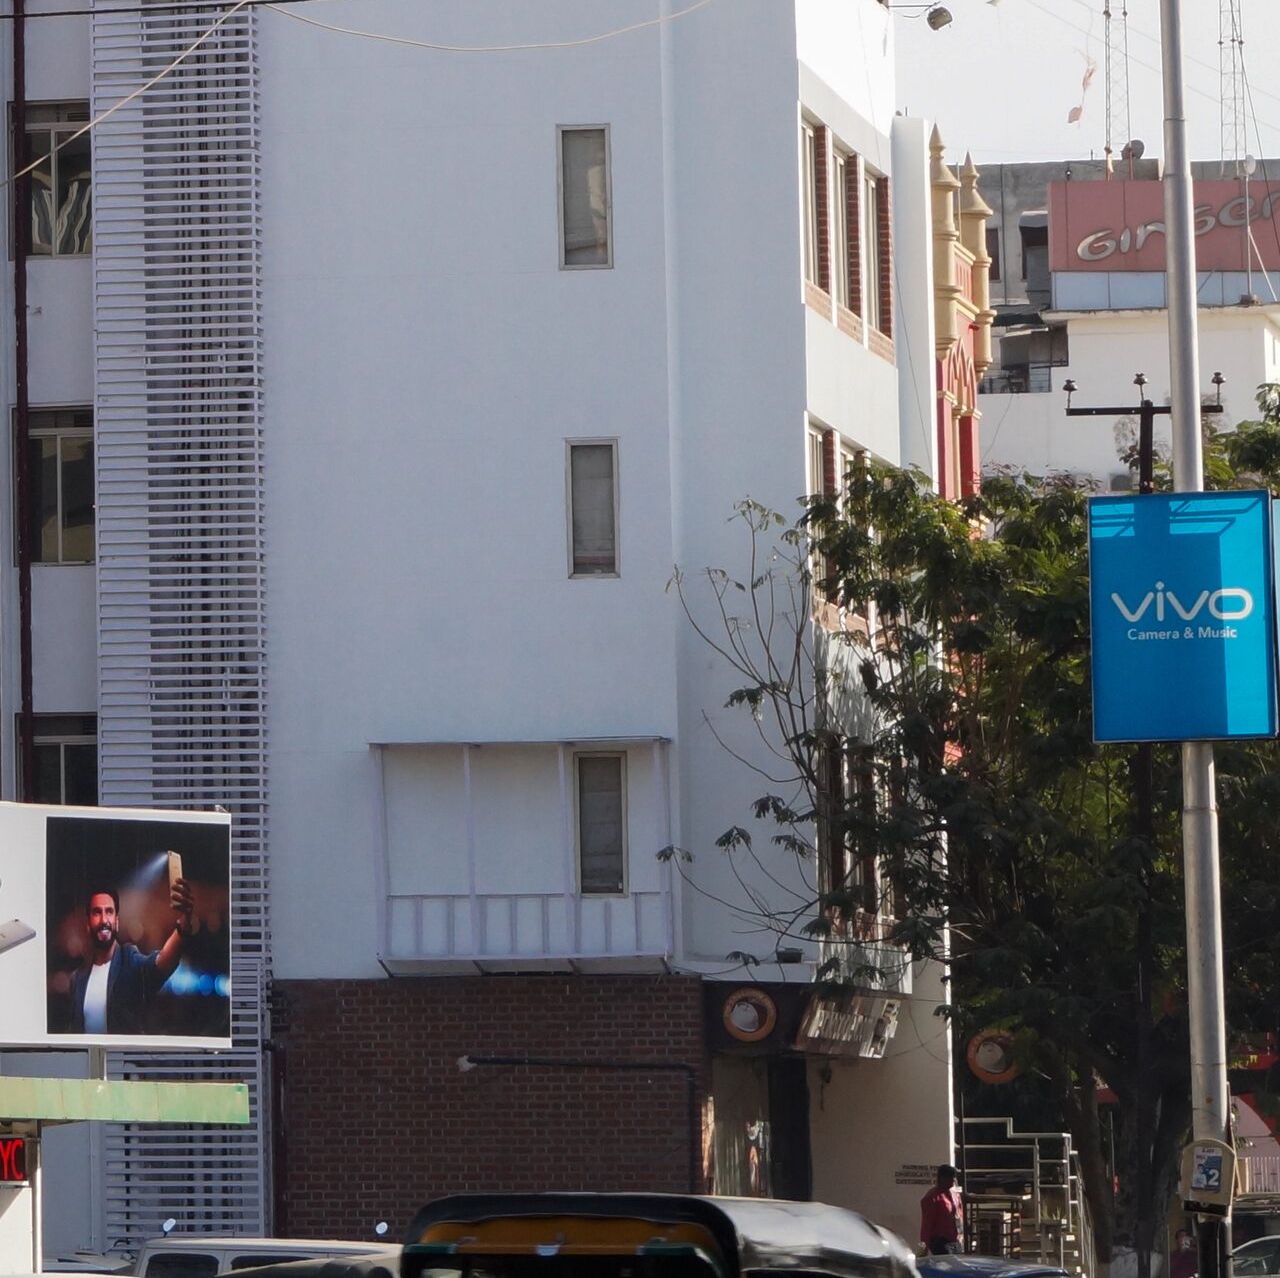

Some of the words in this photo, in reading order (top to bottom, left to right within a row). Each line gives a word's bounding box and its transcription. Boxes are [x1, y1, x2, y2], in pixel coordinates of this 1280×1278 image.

[1111, 580, 1254, 623] vivo
[1127, 628, 1180, 641] Camera
[1183, 626, 1194, 640] &
[1198, 625, 1238, 639] Music
